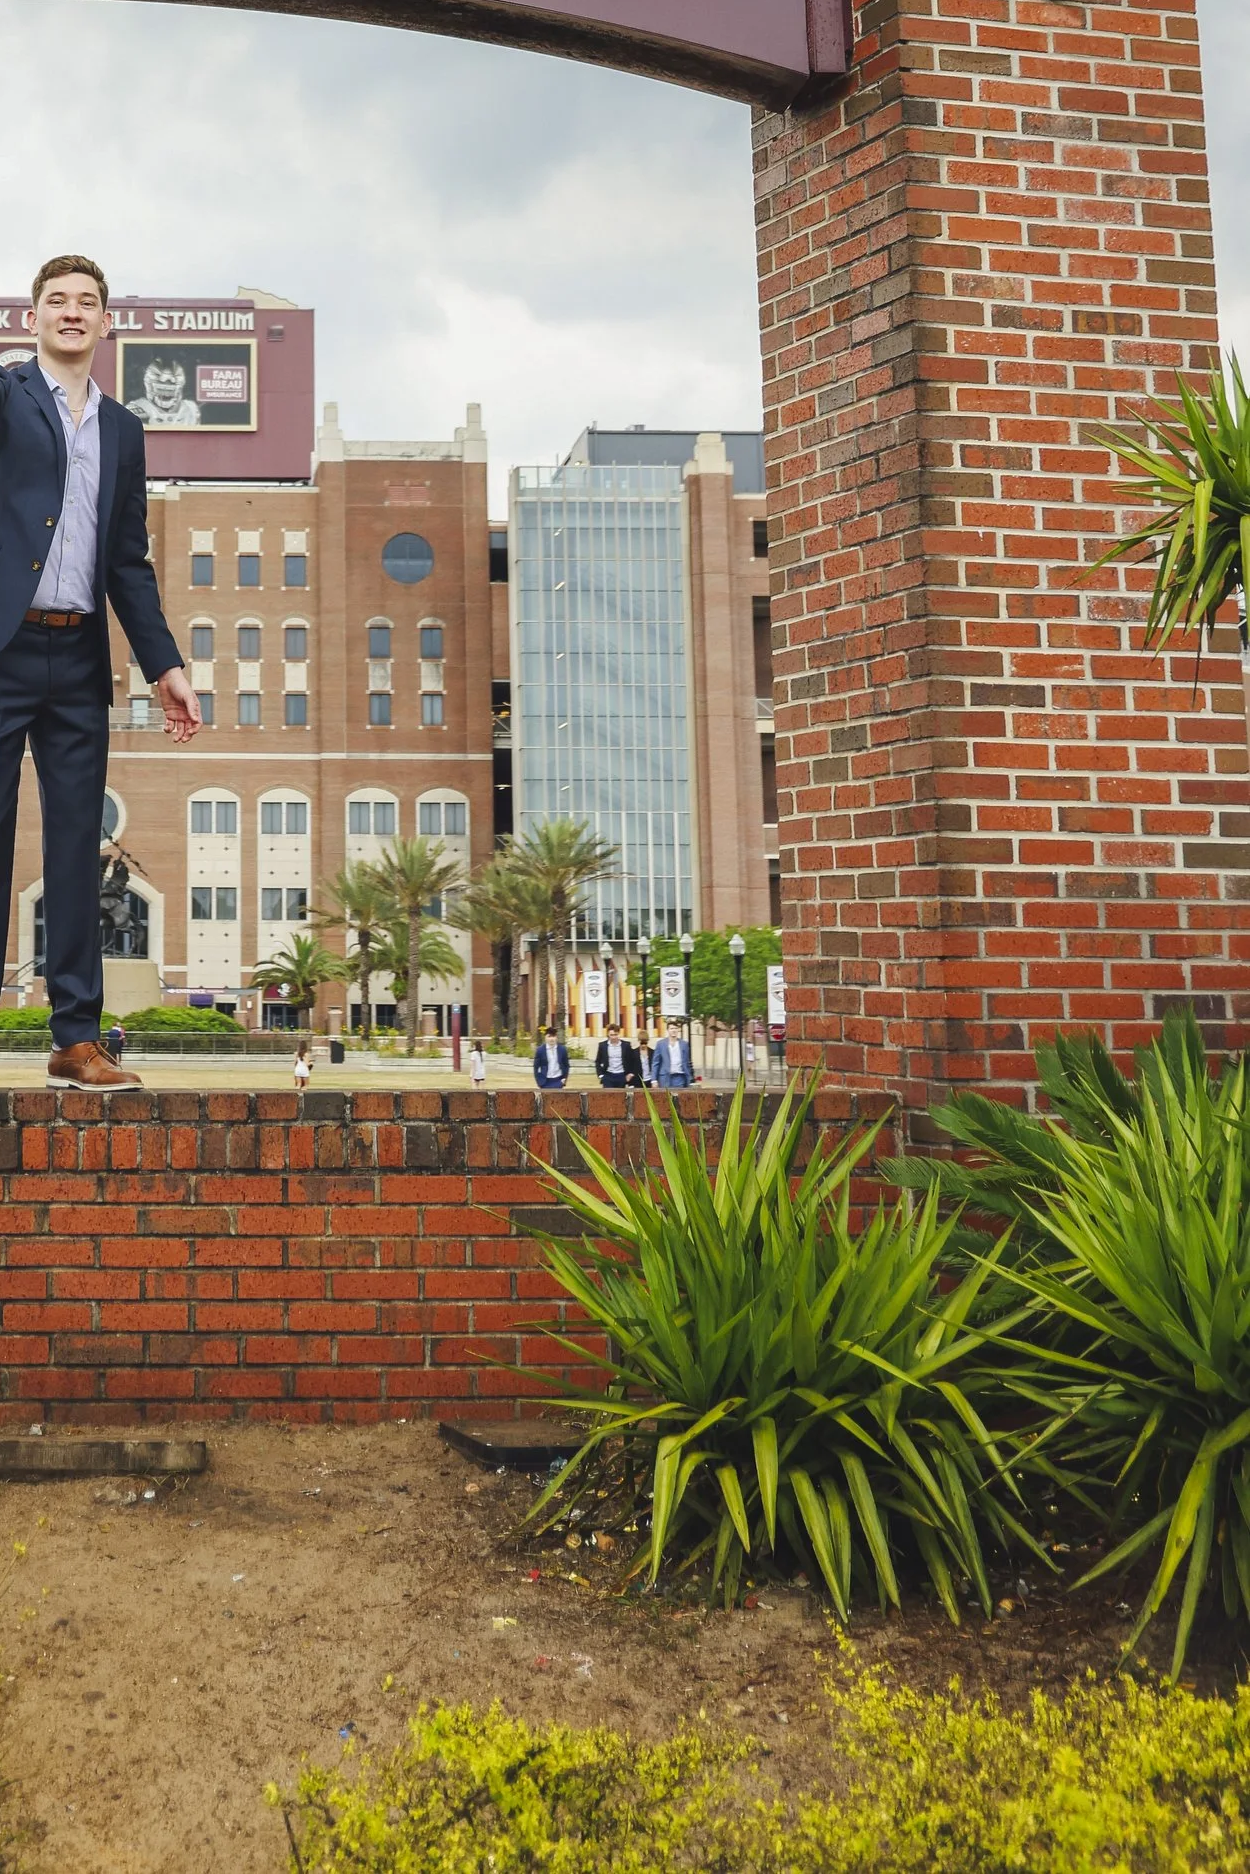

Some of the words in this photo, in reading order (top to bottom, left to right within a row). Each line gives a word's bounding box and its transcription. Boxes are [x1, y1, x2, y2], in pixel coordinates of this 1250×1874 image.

[153, 311, 254, 331] STADIUM
[212, 370, 242, 380] FARM
[201, 379, 243, 389] BUREAU
